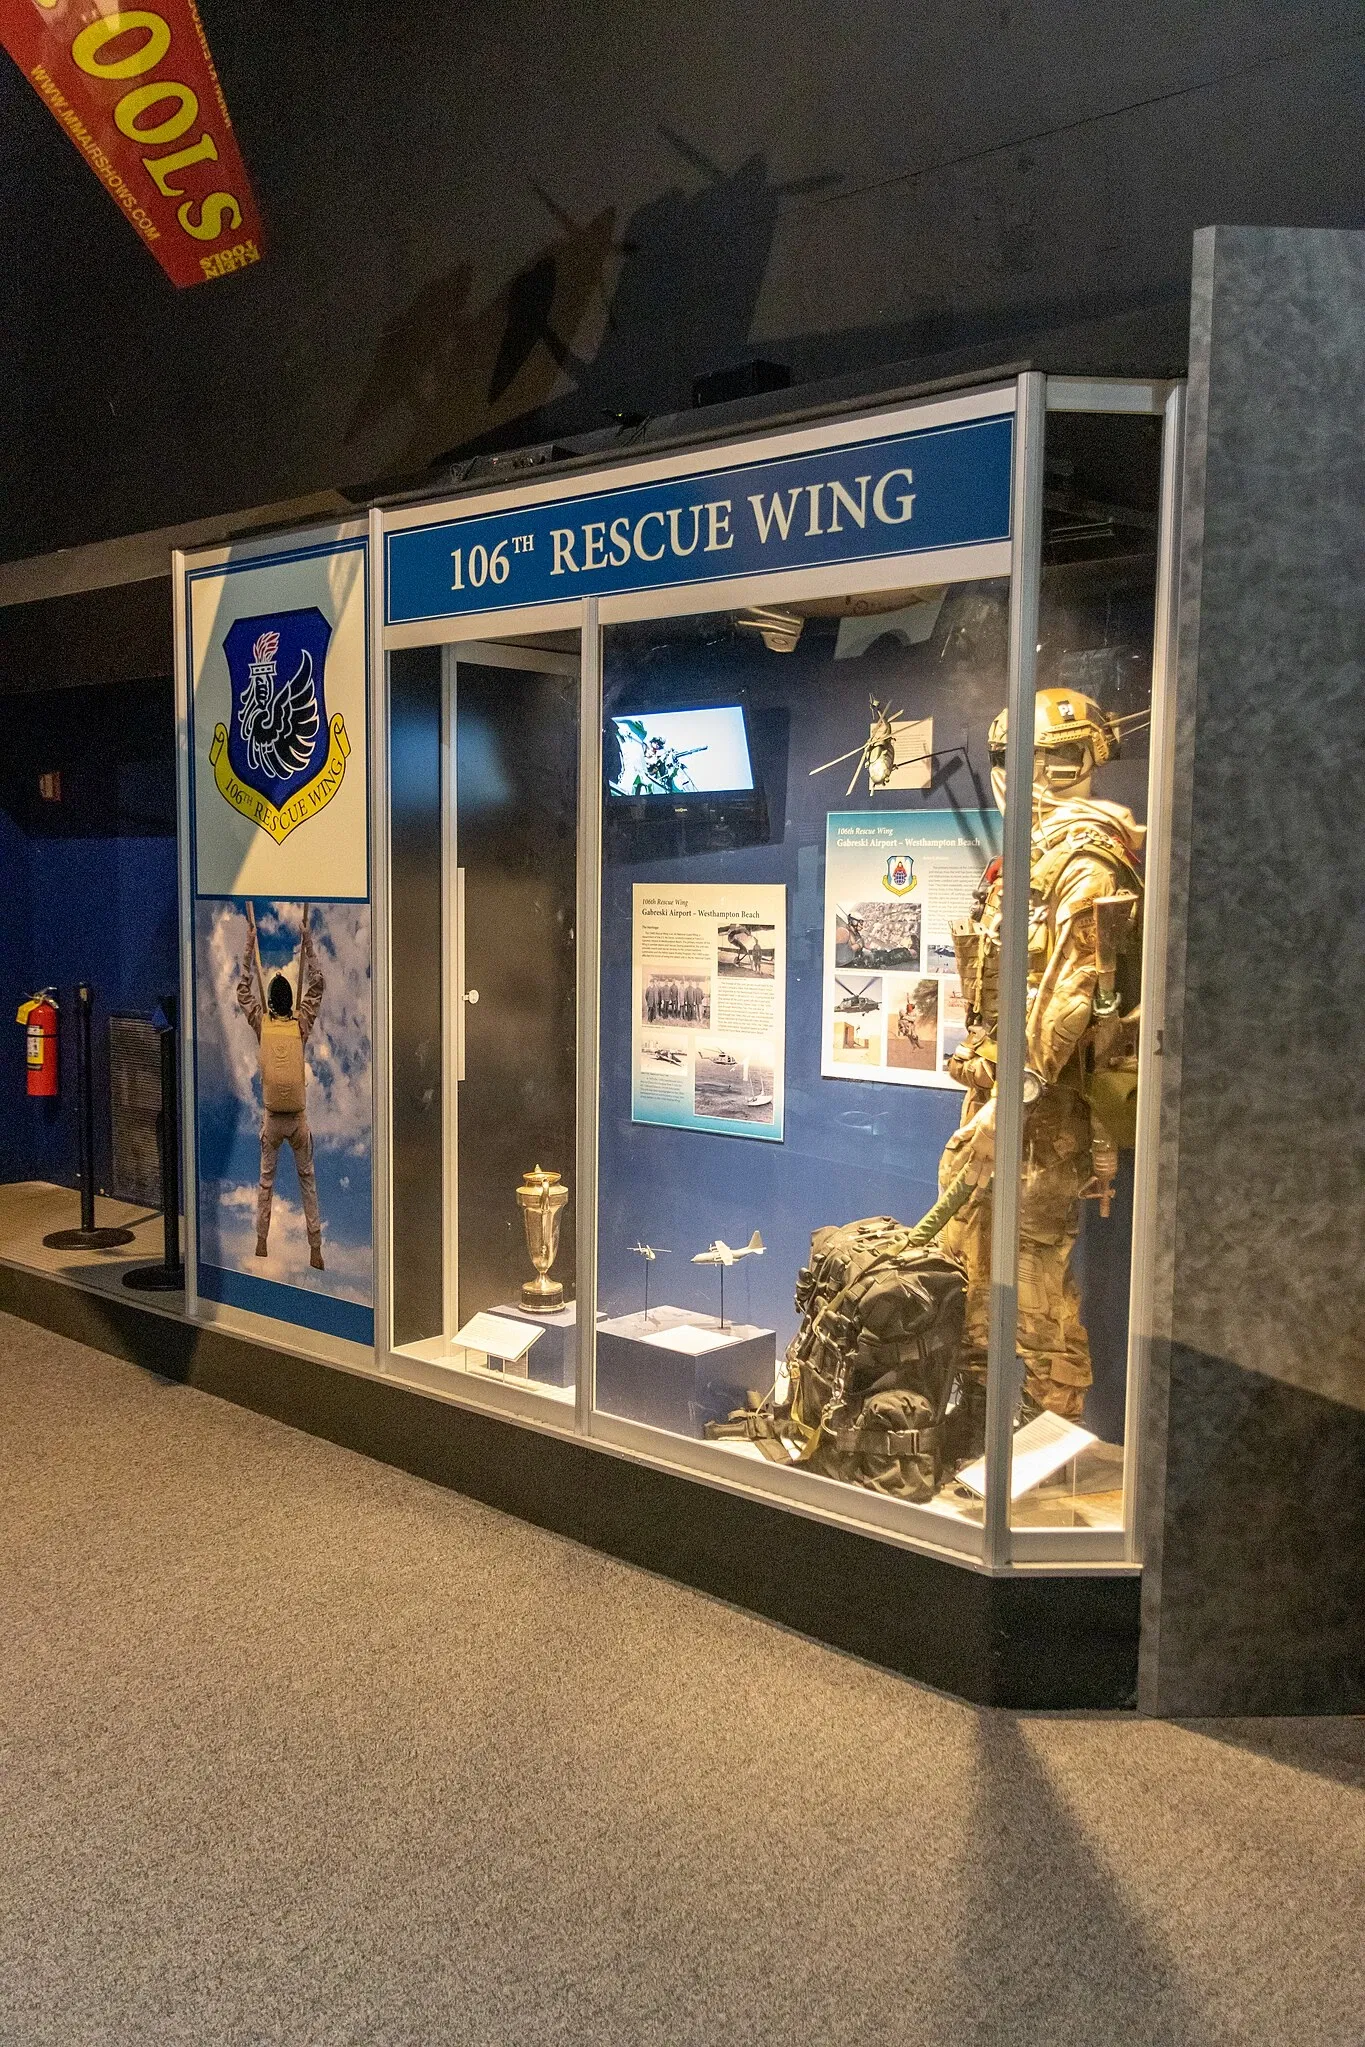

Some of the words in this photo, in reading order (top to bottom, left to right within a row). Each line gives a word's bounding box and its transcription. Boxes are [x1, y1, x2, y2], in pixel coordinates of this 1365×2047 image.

[36, 0, 243, 240] OOLS
[30, 64, 160, 241] WWW.MMAIRSHOWS.COM
[199, 239, 255, 270] TOOLS
[204, 245, 260, 279] KLEIN
[451, 534, 534, 590] 106TH
[550, 500, 733, 575] RESCUE
[747, 468, 917, 544] WING
[226, 778, 253, 806] 106TH
[254, 798, 308, 832] RESCUE
[308, 757, 343, 807] WING
[836, 838, 869, 847] Gabreski
[869, 839, 897, 849] Airport
[905, 838, 956, 849] Westhampton
[957, 838, 981, 847] Beach
[877, 828, 894, 836] Wing
[641, 908, 668, 916] Gabreski
[669, 909, 692, 918] Airport
[697, 909, 740, 919] Westhampton
[741, 910, 760, 919] Beach
[675, 899, 689, 907] Wing
